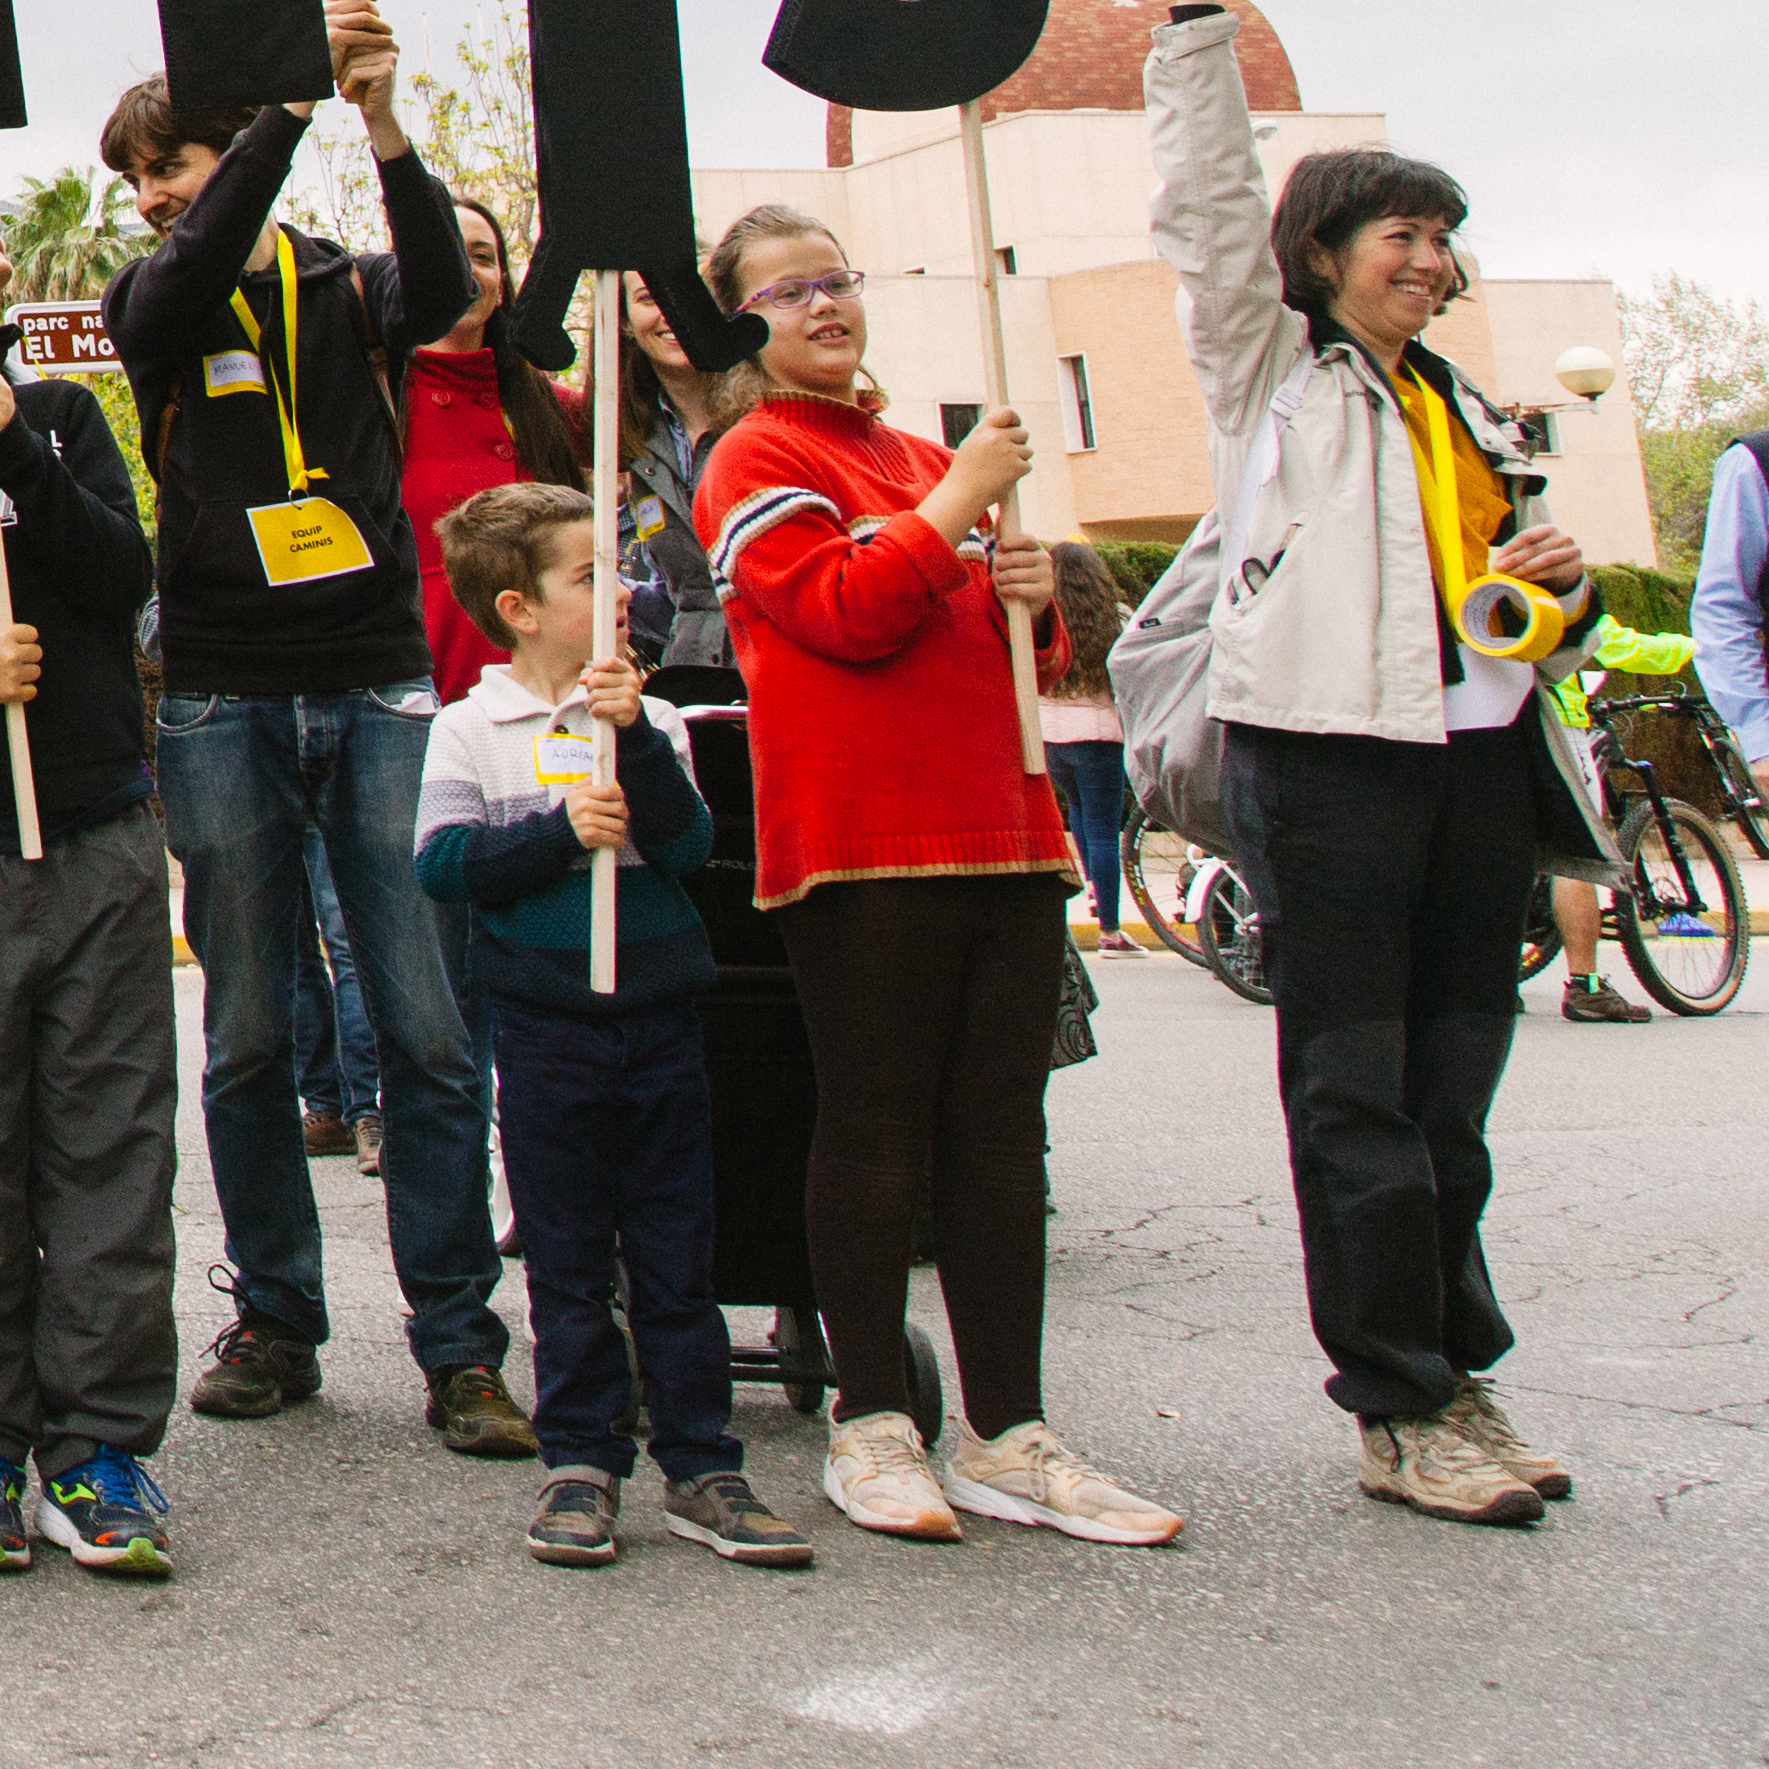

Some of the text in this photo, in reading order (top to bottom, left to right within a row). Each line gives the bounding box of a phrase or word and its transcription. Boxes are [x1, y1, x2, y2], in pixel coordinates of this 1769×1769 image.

[23, 316, 69, 335] parc
[26, 335, 55, 359] El
[291, 525, 322, 539] EQUIP
[289, 537, 333, 552] CAMINIS
